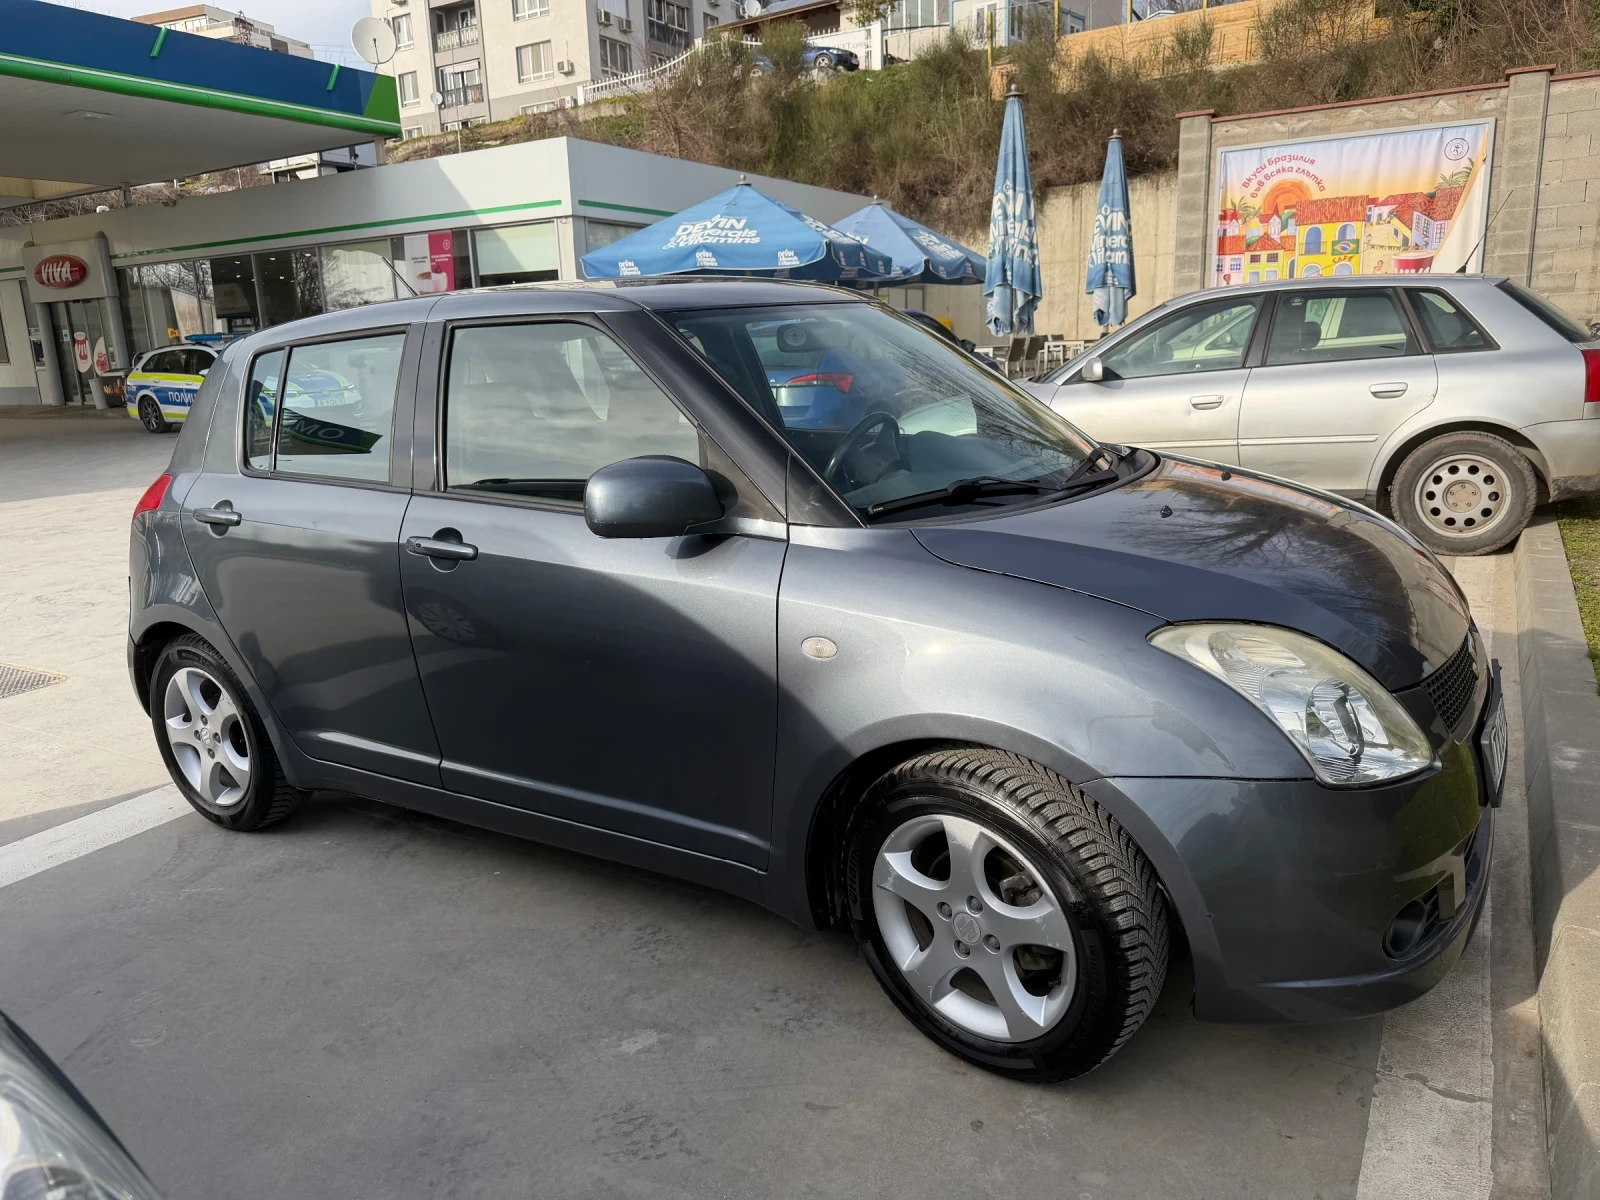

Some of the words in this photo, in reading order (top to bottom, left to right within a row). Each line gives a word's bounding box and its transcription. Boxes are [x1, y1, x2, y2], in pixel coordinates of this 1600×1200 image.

[1241, 163, 1267, 189] Вкуси
[1267, 154, 1316, 166] Бразилия
[1263, 165, 1294, 181] всяка
[1295, 166, 1326, 192] глътка
[675, 215, 747, 235] DEVIN
[676, 228, 758, 244] Minerals
[679, 235, 761, 248] Vitamins
[41, 261, 72, 284] VIVA
